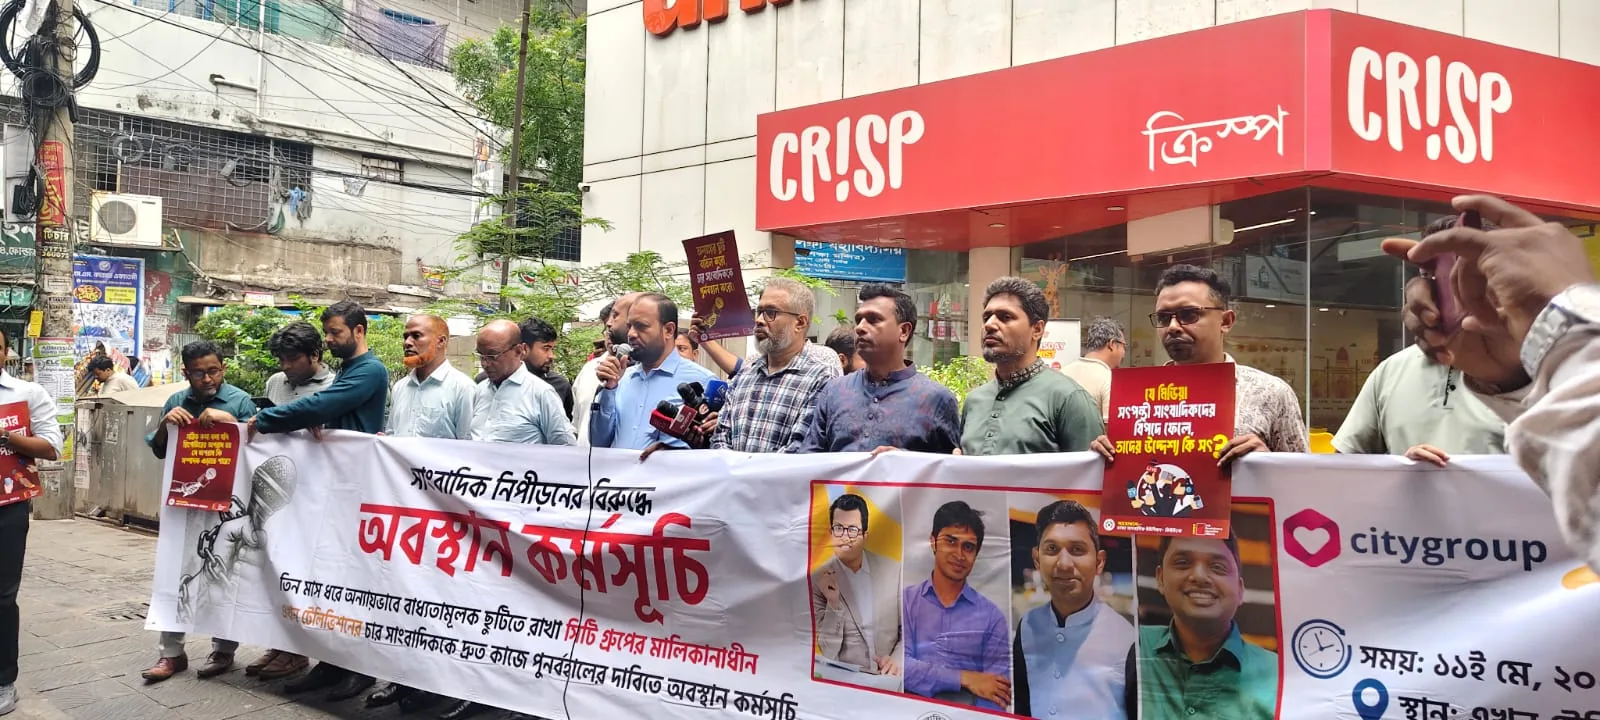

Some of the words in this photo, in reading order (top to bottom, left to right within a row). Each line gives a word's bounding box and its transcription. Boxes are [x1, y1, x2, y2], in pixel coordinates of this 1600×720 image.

[1141, 105, 1290, 171] ক্রিস্প
[1145, 387, 1155, 401] যে
[1158, 383, 1188, 400] মিডিয়া
[1153, 400, 1216, 419] সাংবাদিকদের
[1134, 420, 1161, 436] বিপদে
[1182, 436, 1195, 453] কি
[410, 466, 493, 499] সাংবাদিক
[492, 470, 588, 512] নিপীড়নের
[590, 478, 656, 514] বিরুদ্ধে
[358, 503, 513, 578] অবস্থান
[520, 512, 710, 625] কর্মসূচি
[1350, 527, 1548, 571] citygroup
[280, 572, 302, 594] তিন
[303, 580, 323, 598] মাস
[345, 588, 402, 613] অন্যায়ভাবে
[403, 597, 481, 630] বাধ্যতামূলক
[483, 605, 526, 635] ছুটিতে
[527, 615, 562, 641] রাখা
[564, 617, 598, 647] সিটি
[598, 627, 647, 655] গ্রুপের
[650, 634, 759, 674] মালিকানাধীন
[302, 605, 363, 637] টেলিভিশনের
[364, 621, 383, 641] চার
[385, 625, 459, 654] সাংবাদিককে
[459, 640, 487, 661] দ্রুত
[489, 644, 530, 670] কাজে
[611, 664, 664, 695] দাবিতে
[666, 677, 729, 710] অবস্থান
[1359, 646, 1424, 676] সময়:
[1434, 650, 1487, 682] ১১ই
[1497, 660, 1542, 692] মে,
[1554, 665, 1600, 693] ২০
